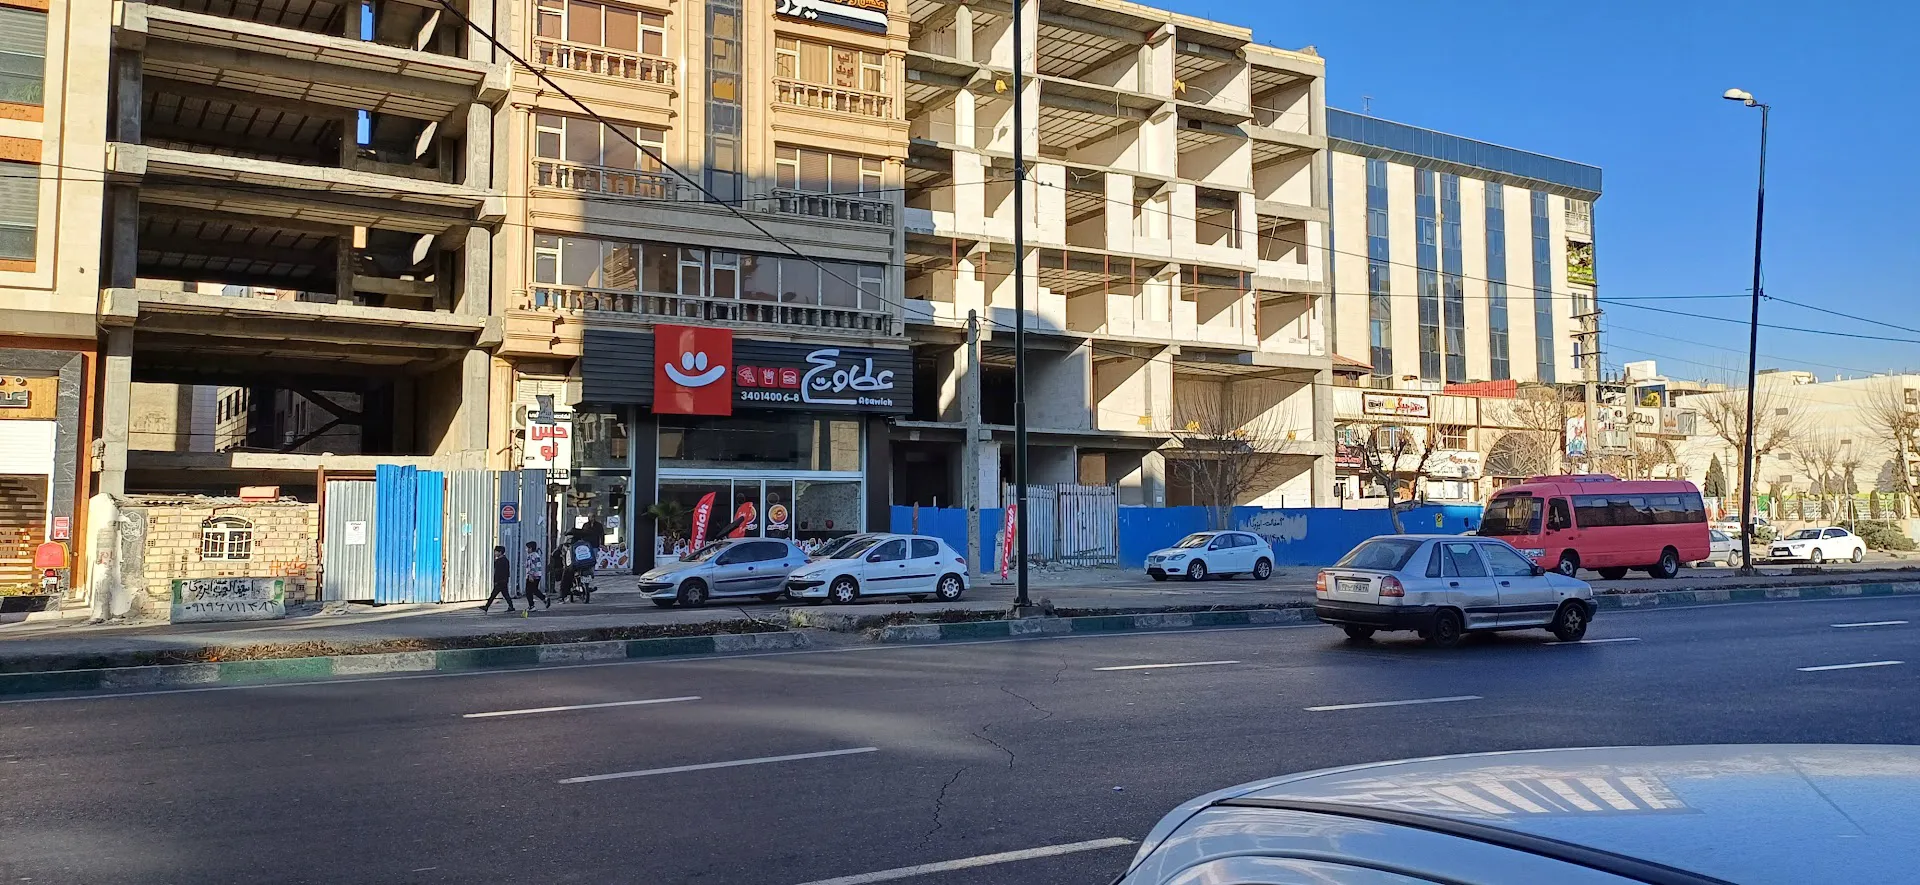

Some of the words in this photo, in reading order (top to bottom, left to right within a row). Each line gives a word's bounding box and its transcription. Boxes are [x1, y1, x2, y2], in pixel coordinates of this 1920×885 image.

[741, 391, 782, 401] 3401400
[783, 393, 800, 402] 6-8
[858, 396, 893, 407] Atawich
[531, 426, 568, 441] حس
[540, 442, 559, 462] نو
